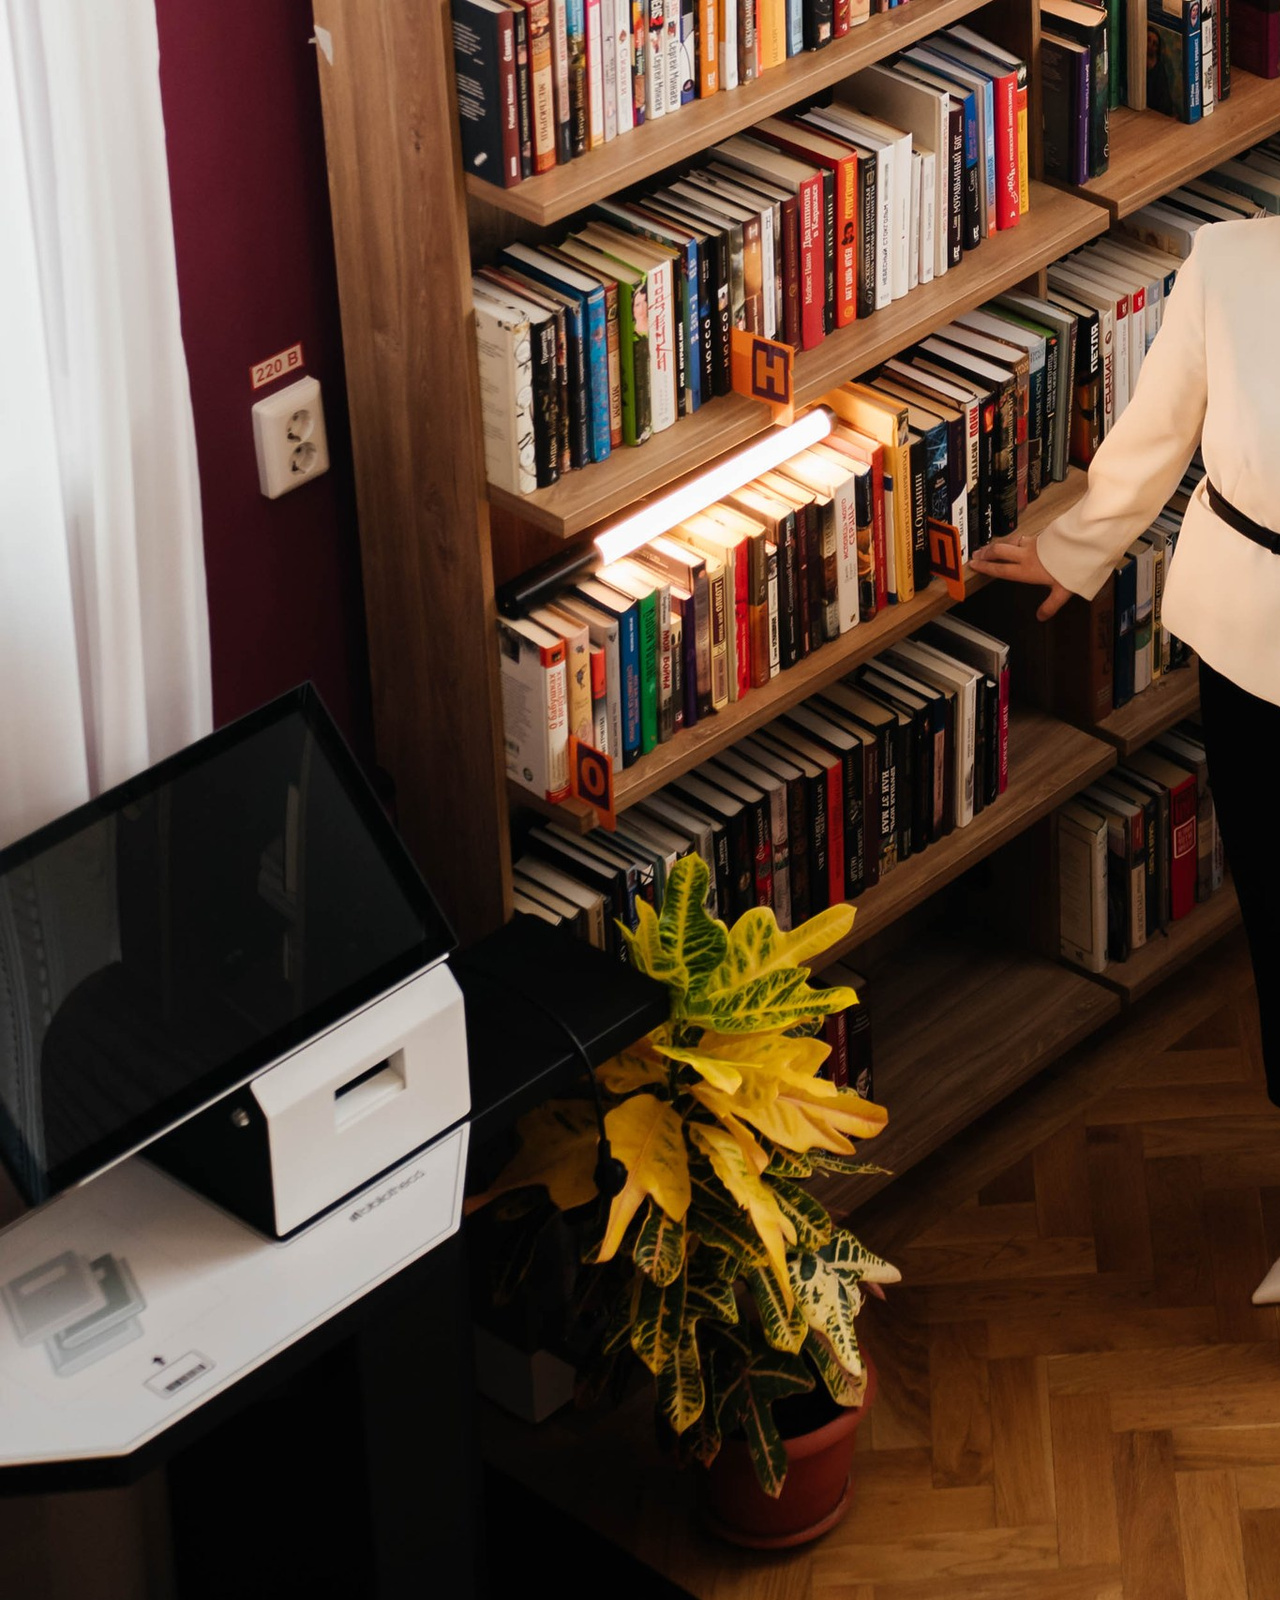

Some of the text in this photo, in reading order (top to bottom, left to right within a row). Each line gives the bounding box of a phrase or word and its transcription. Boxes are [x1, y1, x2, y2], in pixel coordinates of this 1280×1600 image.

[652, 53, 663, 112] Сергей Минаев
[668, 42, 678, 107] Сергей Минаев
[538, 83, 548, 142] МЕТЬЮРИН
[1006, 128, 1014, 161] рассказы
[952, 135, 962, 214] МУРАВЬИНЫЙ БОГ
[802, 188, 812, 249] Два шпиона
[810, 184, 821, 230] Каракасе
[704, 319, 712, 373] МЮССО
[721, 312, 729, 367] МЮССО
[1090, 323, 1099, 374] ПЕТЛЯ
[256, 351, 299, 382] 220 В
[757, 351, 785, 395] Н
[1104, 355, 1113, 414] СЕНЧИН
[932, 533, 955, 573] П
[548, 673, 559, 720] бабушках
[555, 671, 566, 718] дедушках
[581, 756, 606, 798] О
